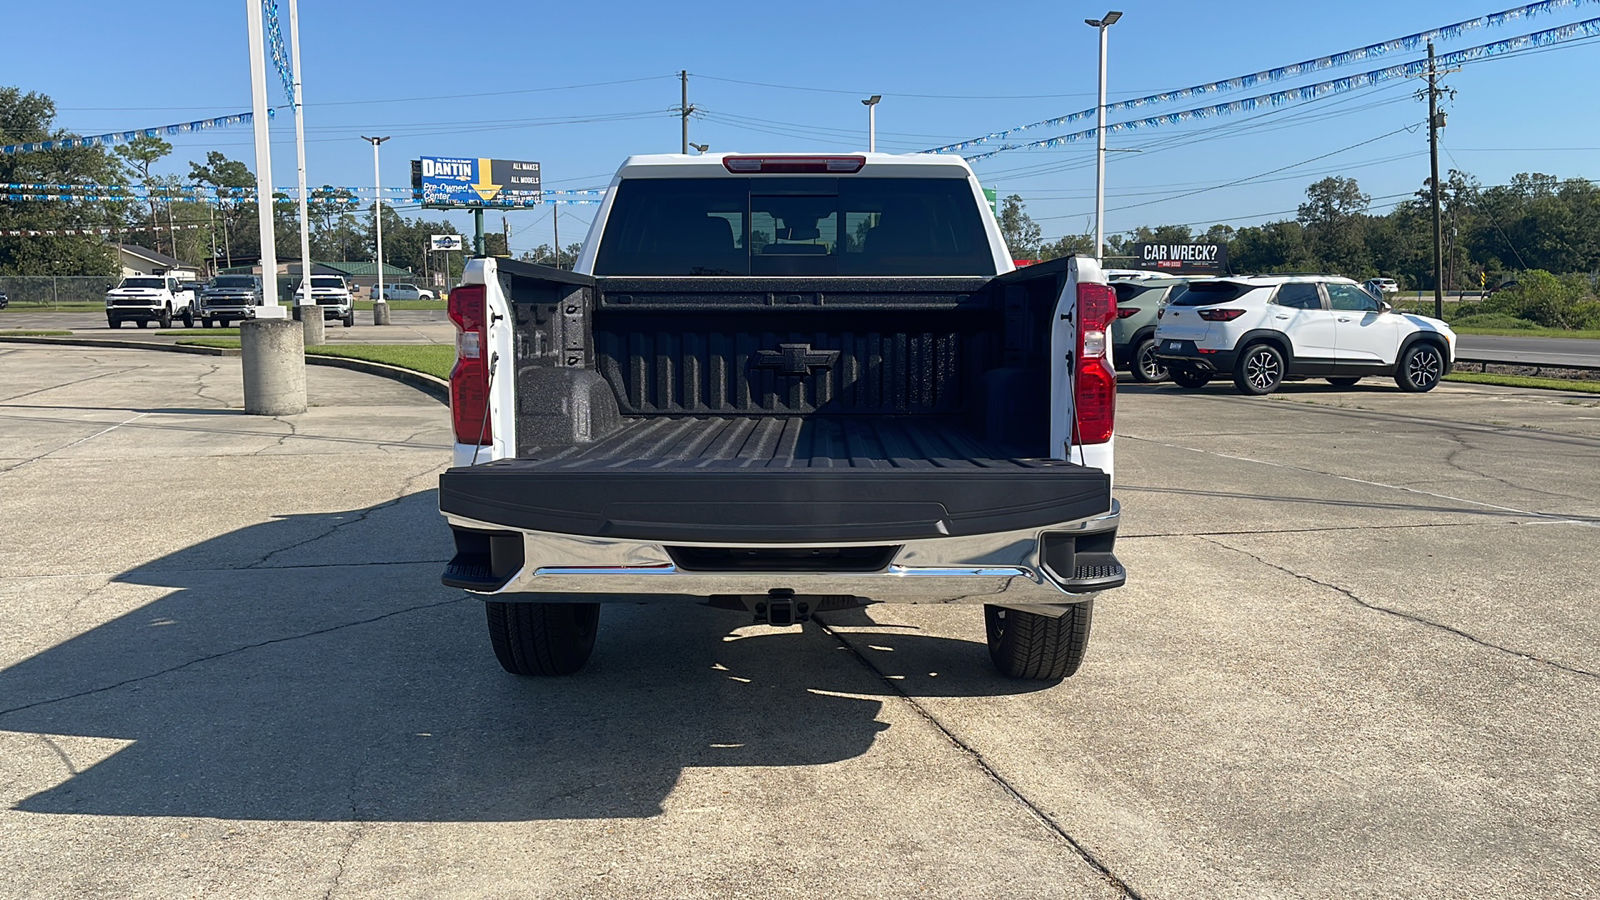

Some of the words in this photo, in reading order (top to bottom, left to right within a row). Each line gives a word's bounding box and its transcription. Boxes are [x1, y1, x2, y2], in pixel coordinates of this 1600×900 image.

[422, 159, 472, 177] DANTIN
[513, 162, 522, 170] ALL
[522, 163, 539, 171] MAKES
[511, 175, 520, 184] ALL
[520, 176, 539, 184] MODELS
[423, 182, 469, 192] Pre-Owned
[423, 191, 451, 200] Center
[1144, 244, 1167, 260] CAR
[1170, 244, 1218, 261] WRECK?
